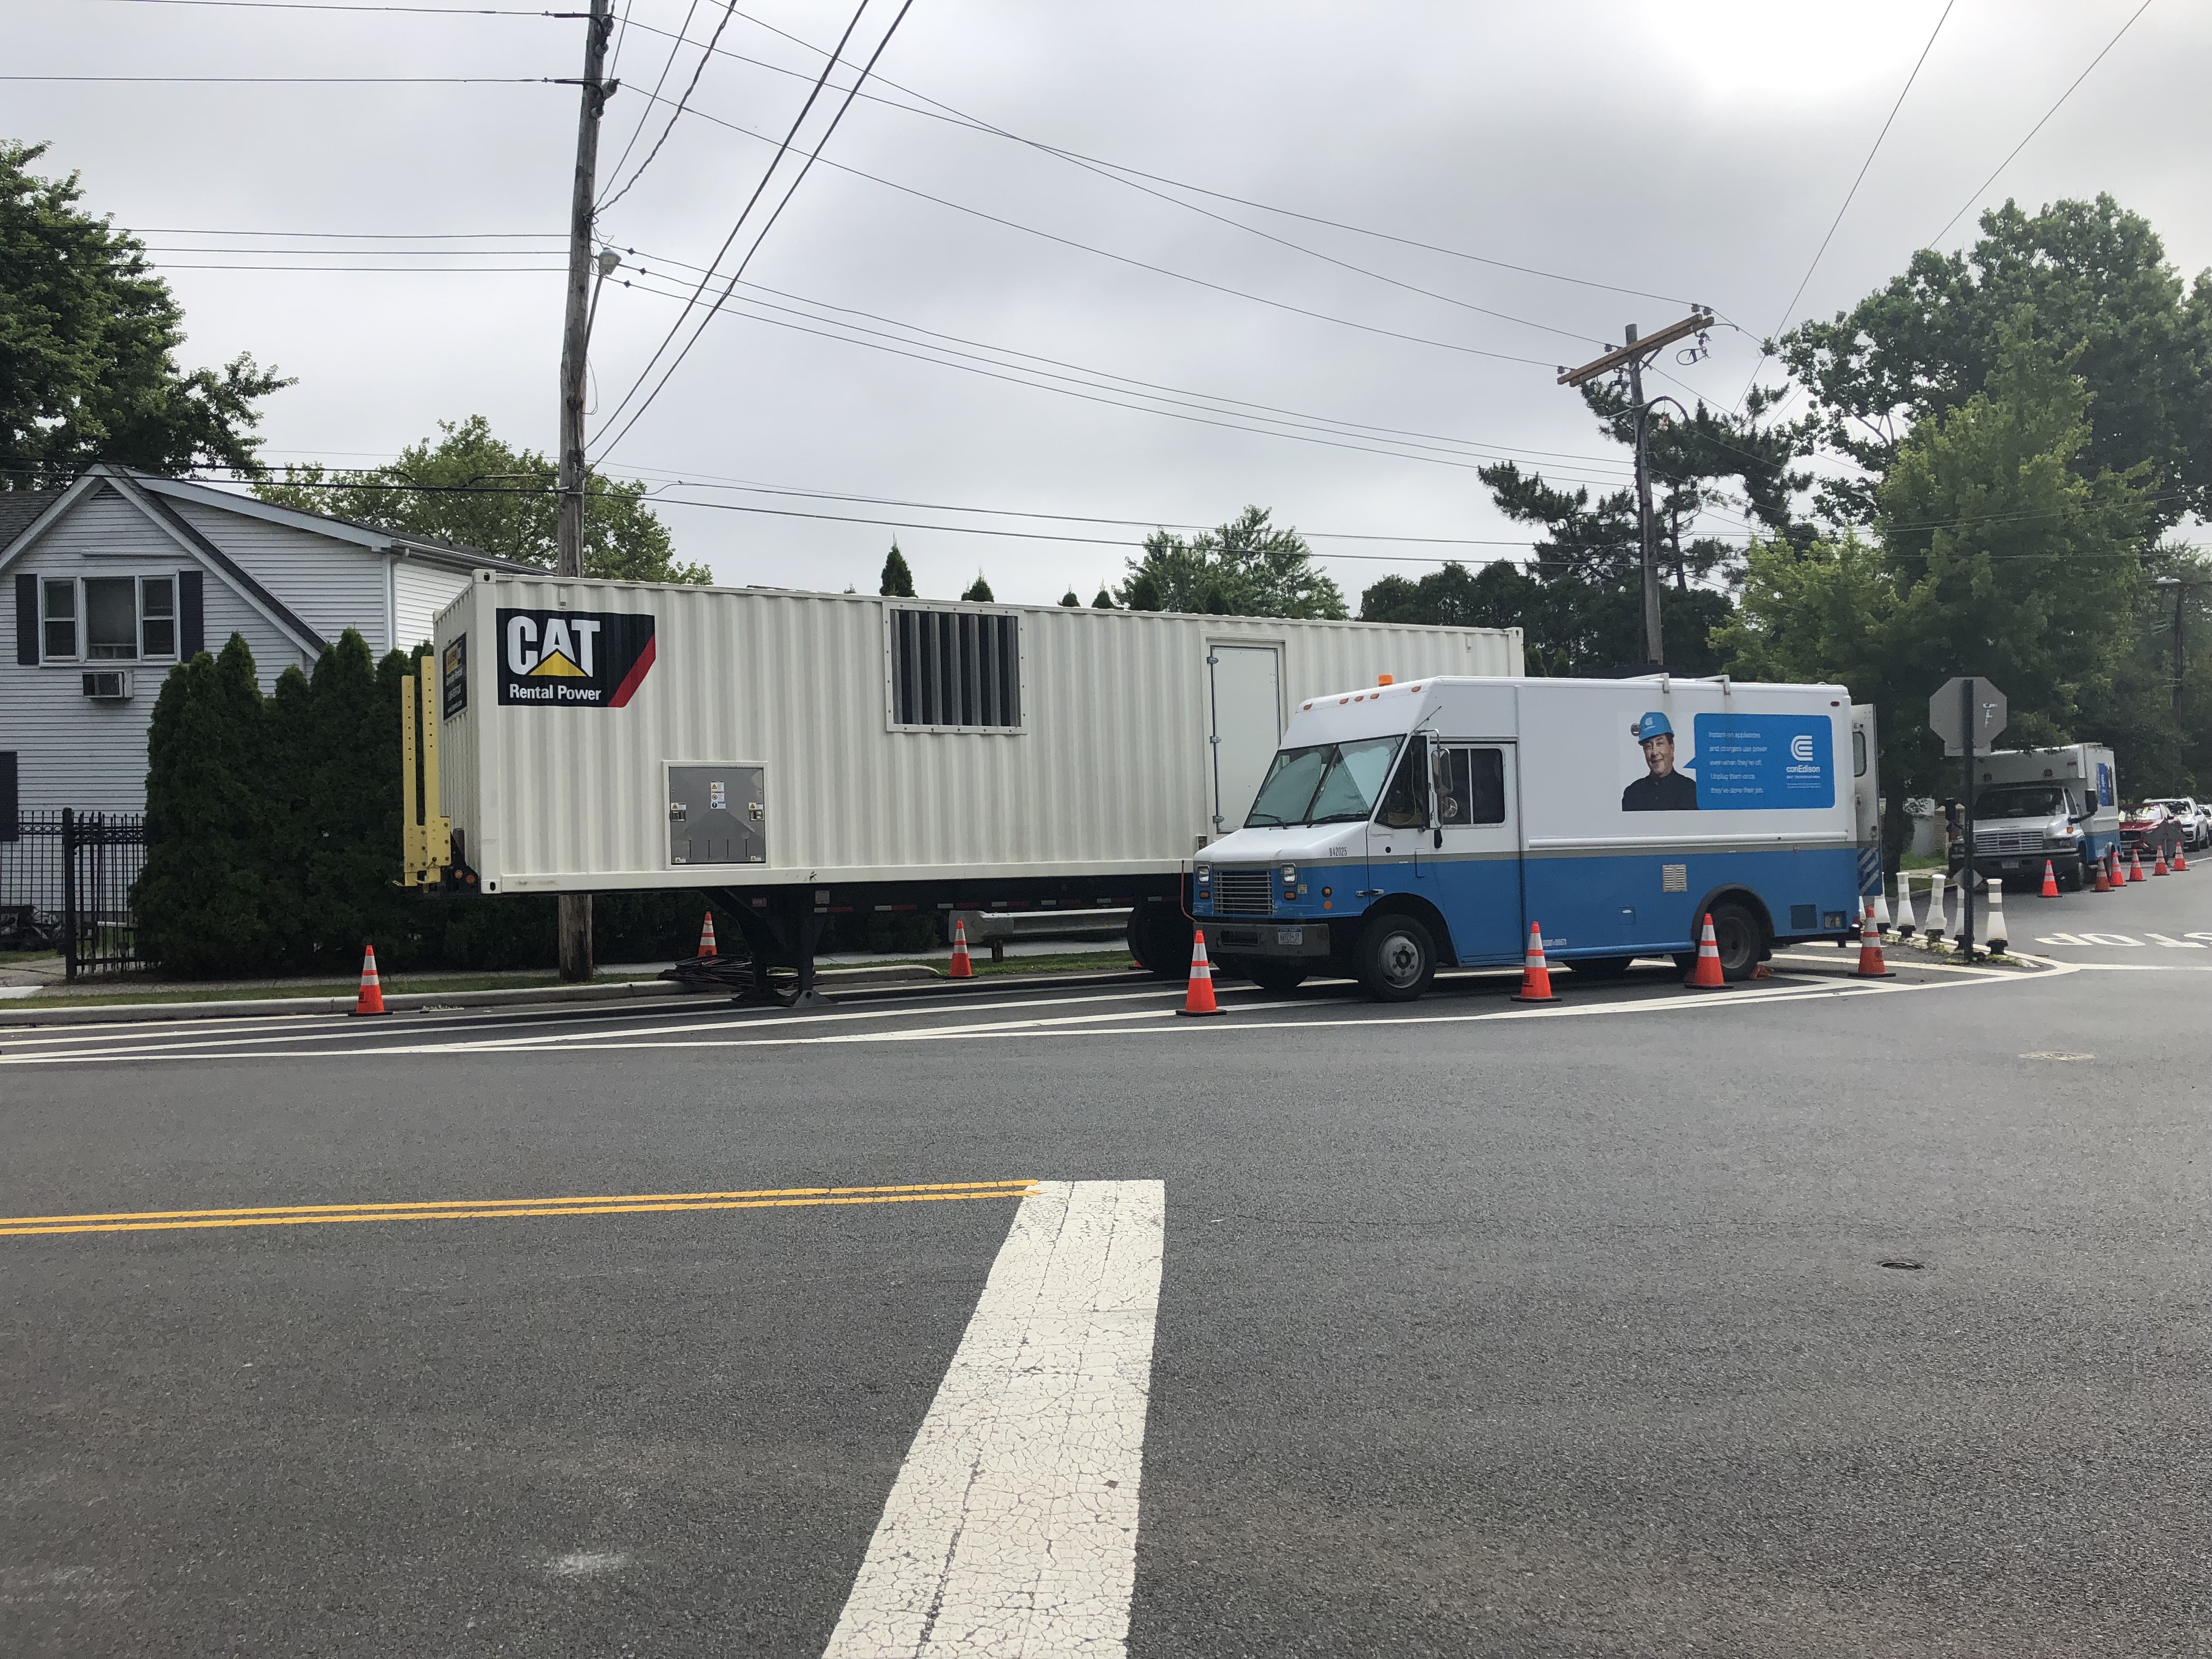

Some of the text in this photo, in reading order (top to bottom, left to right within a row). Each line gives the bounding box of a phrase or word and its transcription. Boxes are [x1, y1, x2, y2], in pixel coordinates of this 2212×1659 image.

[507, 616, 601, 678] CAT
[510, 684, 601, 701] Rental Power
